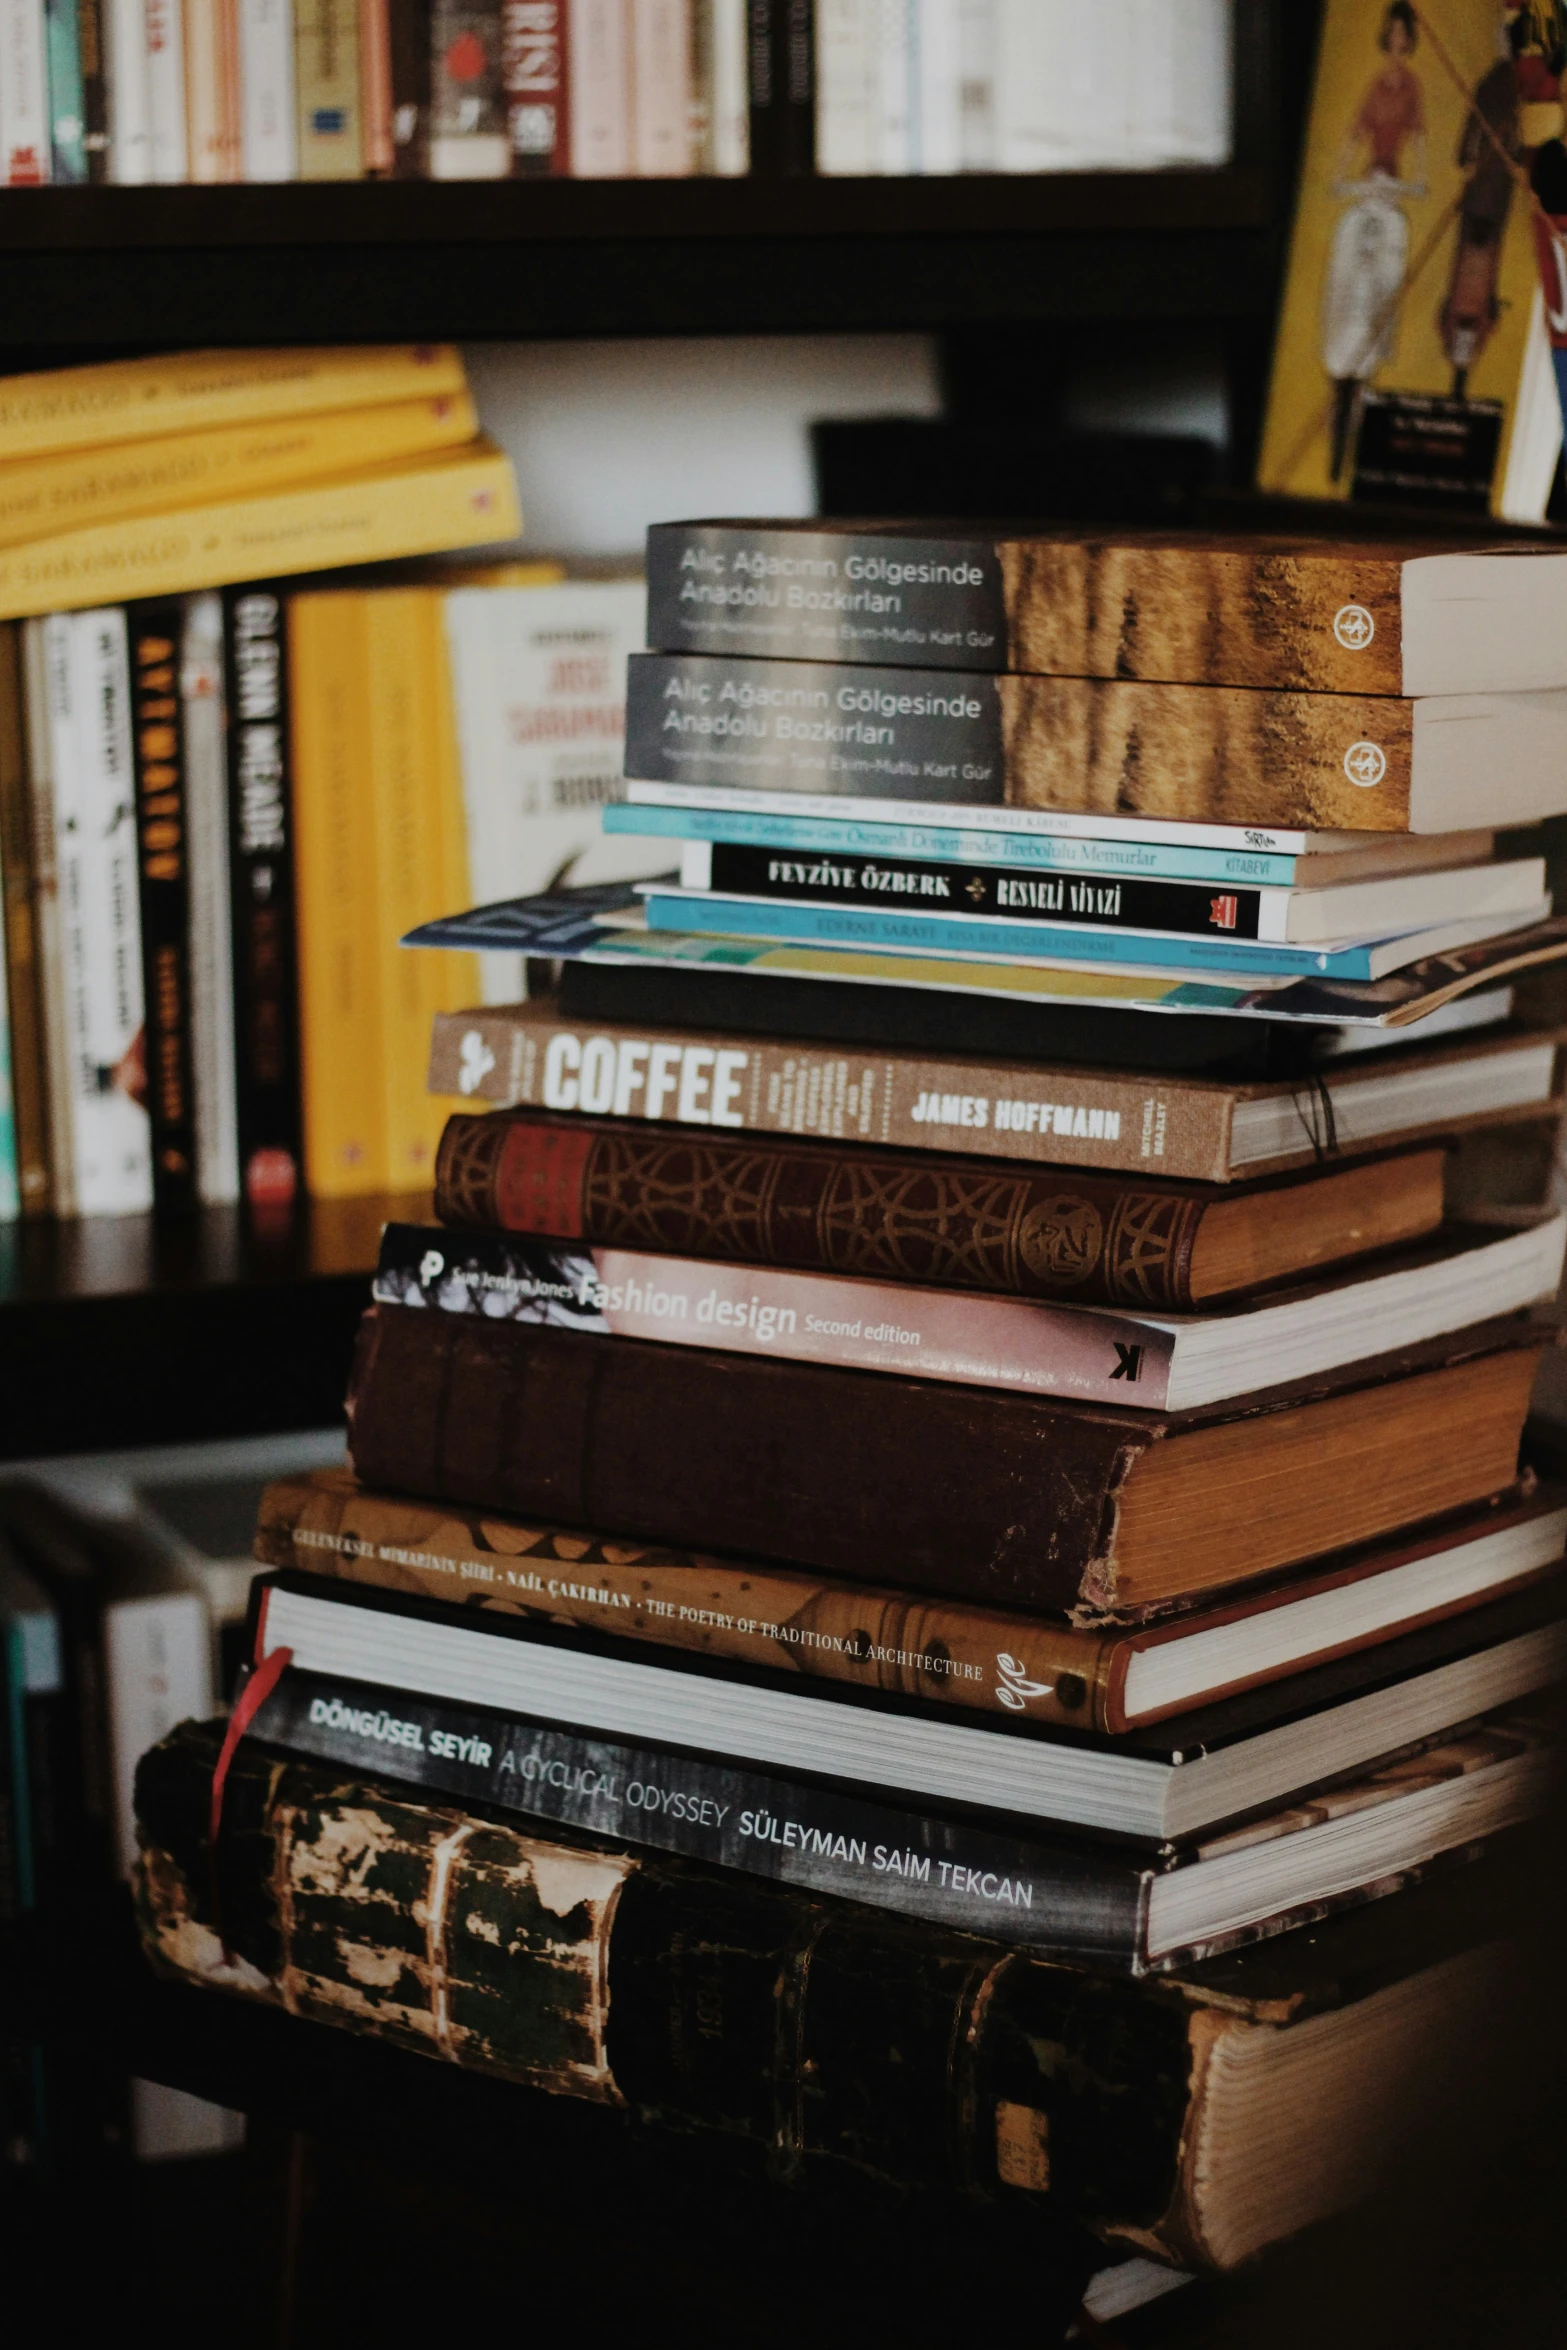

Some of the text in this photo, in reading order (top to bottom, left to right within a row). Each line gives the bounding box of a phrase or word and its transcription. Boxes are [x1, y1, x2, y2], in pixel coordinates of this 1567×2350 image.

[732, 549, 837, 579] Ağacının
[844, 555, 983, 588] Gölgesinde
[679, 580, 901, 614] Anadolu Bozkırları
[232, 592, 281, 722] GLENN
[719, 680, 828, 710] Ağacının
[836, 685, 982, 719] Gölgesinde
[662, 709, 895, 746] Anadolu Bozkırları
[236, 723, 287, 854] MEADE
[1002, 838, 1076, 861] Tirebolulu
[1081, 845, 1157, 868] Memurlar
[1225, 854, 1271, 876] KİTABEVİ
[768, 858, 951, 897] FEYZİYE ÖZBERK
[997, 877, 1064, 912] RESNELİ
[542, 1032, 749, 1129] COFFEE
[911, 1092, 989, 1130] JAMES
[994, 1098, 1121, 1141] HOFFMANN
[1140, 1097, 1155, 1158] MITCHELL
[1153, 1102, 1167, 1156] BEAZLEY
[533, 1278, 574, 1299] Jones
[577, 1275, 920, 1346] Fashion design Second edition
[506, 1565, 545, 1592] NAİL
[547, 1578, 631, 1610] ÇAKIRHAN
[646, 1598, 676, 1619] THE
[679, 1605, 734, 1631] POETRY
[737, 1615, 758, 1635] OF
[760, 1621, 863, 1658] TRADITIONAL
[866, 1643, 984, 1682] ARCHITECTURE
[309, 1697, 1034, 1911] DÖNGÜSEL SEYİR A CYCLICAL ODYSSEY SÜLEYMAN SAİM TEKCAN
